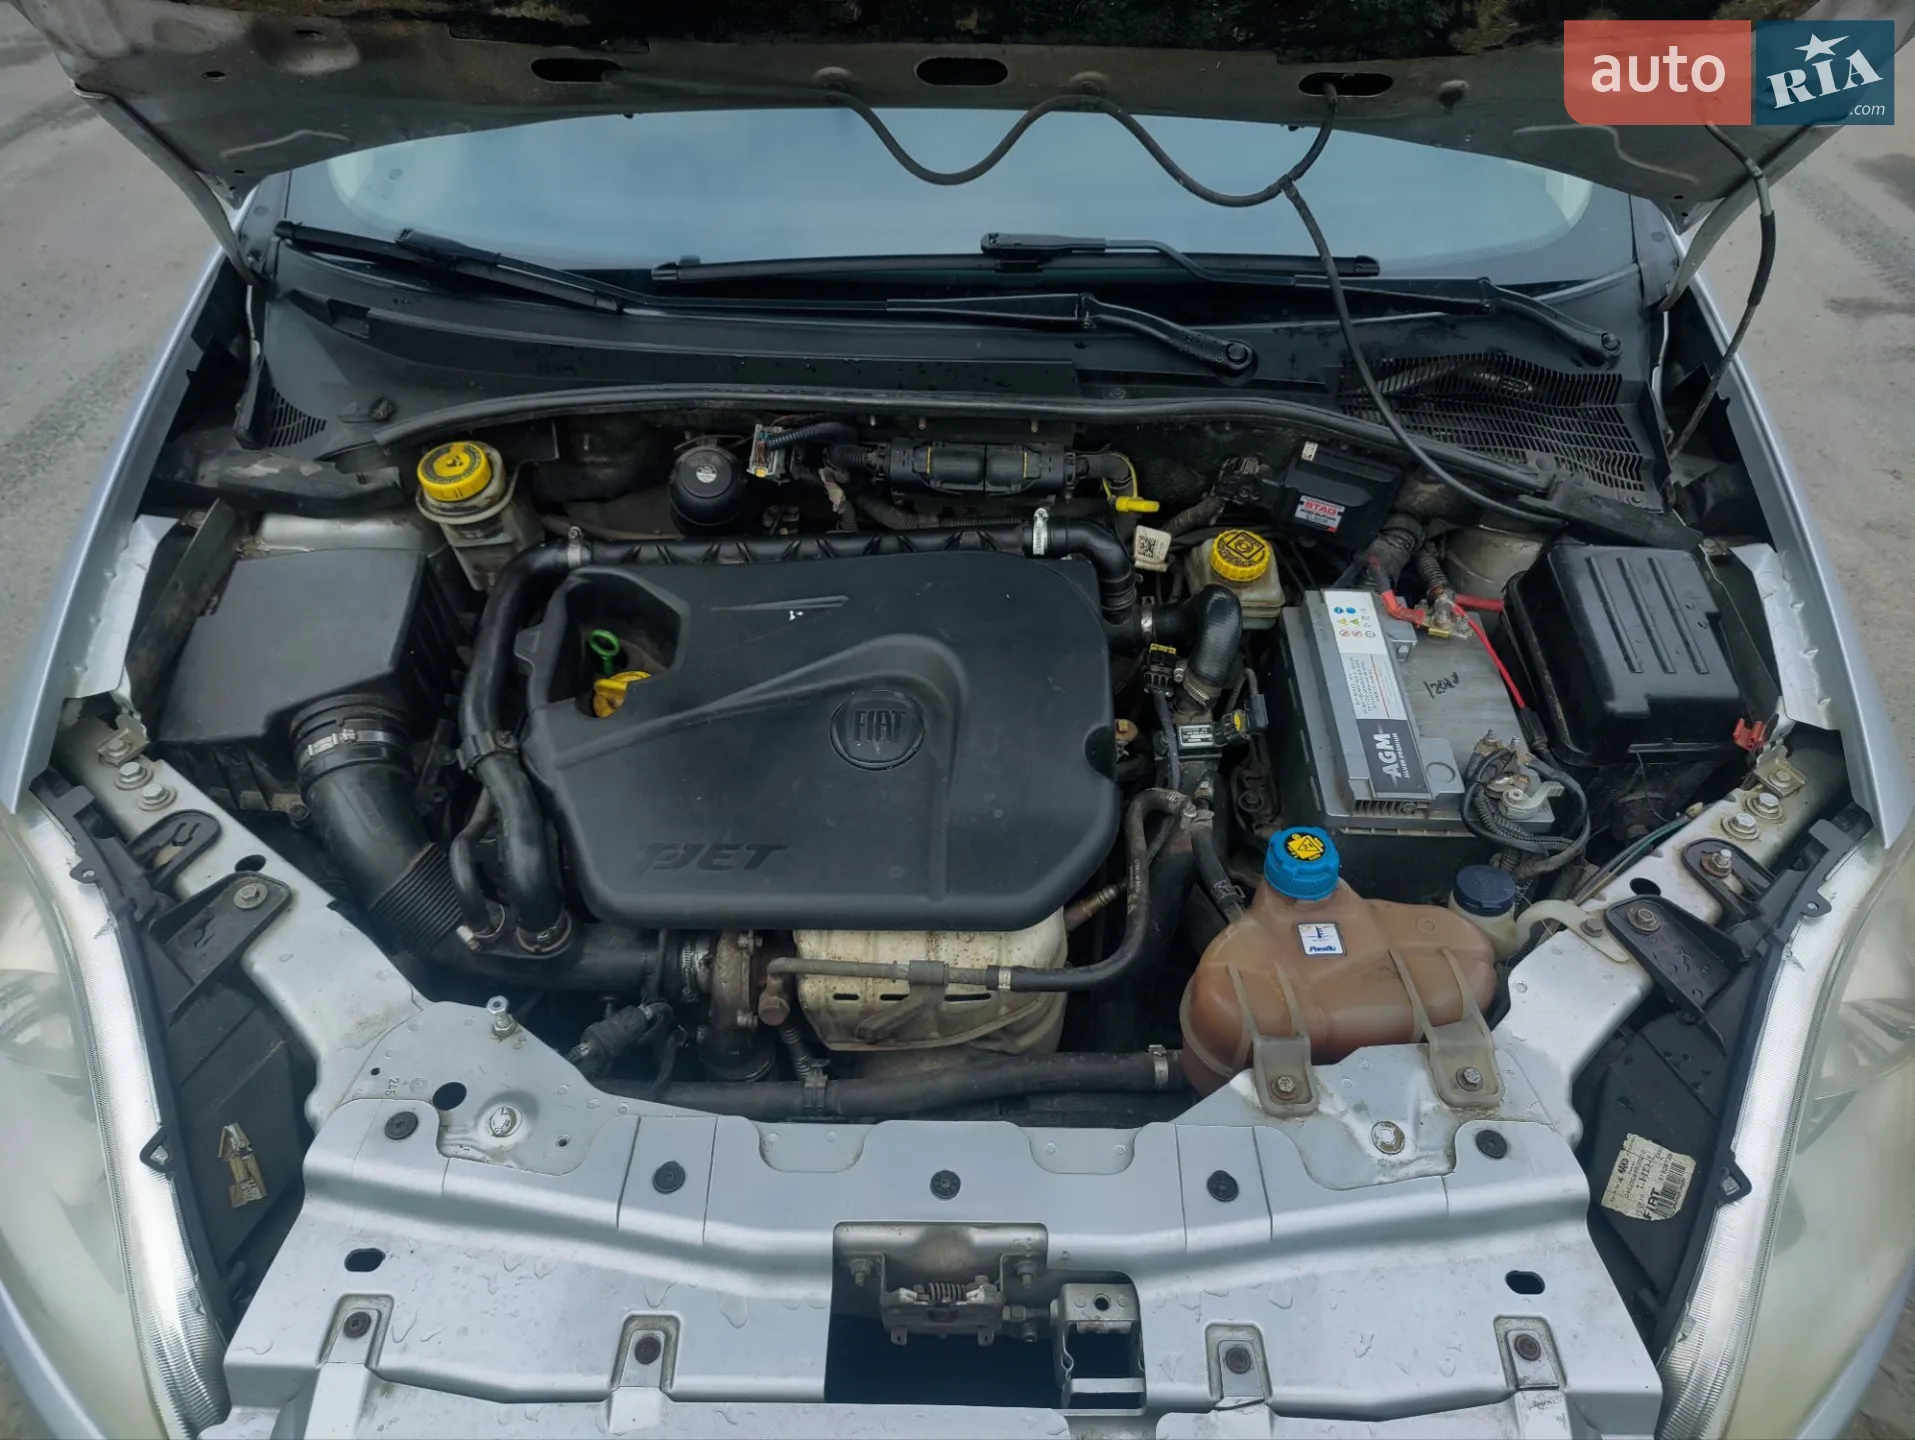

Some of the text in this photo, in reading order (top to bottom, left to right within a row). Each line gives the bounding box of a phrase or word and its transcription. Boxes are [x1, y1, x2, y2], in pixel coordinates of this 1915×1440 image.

[854, 710, 907, 743] FIAT
[1373, 733, 1402, 779] AGM
[1392, 733, 1411, 778] SILVER PREMIUM
[1642, 1187, 1661, 1220] FIAT
